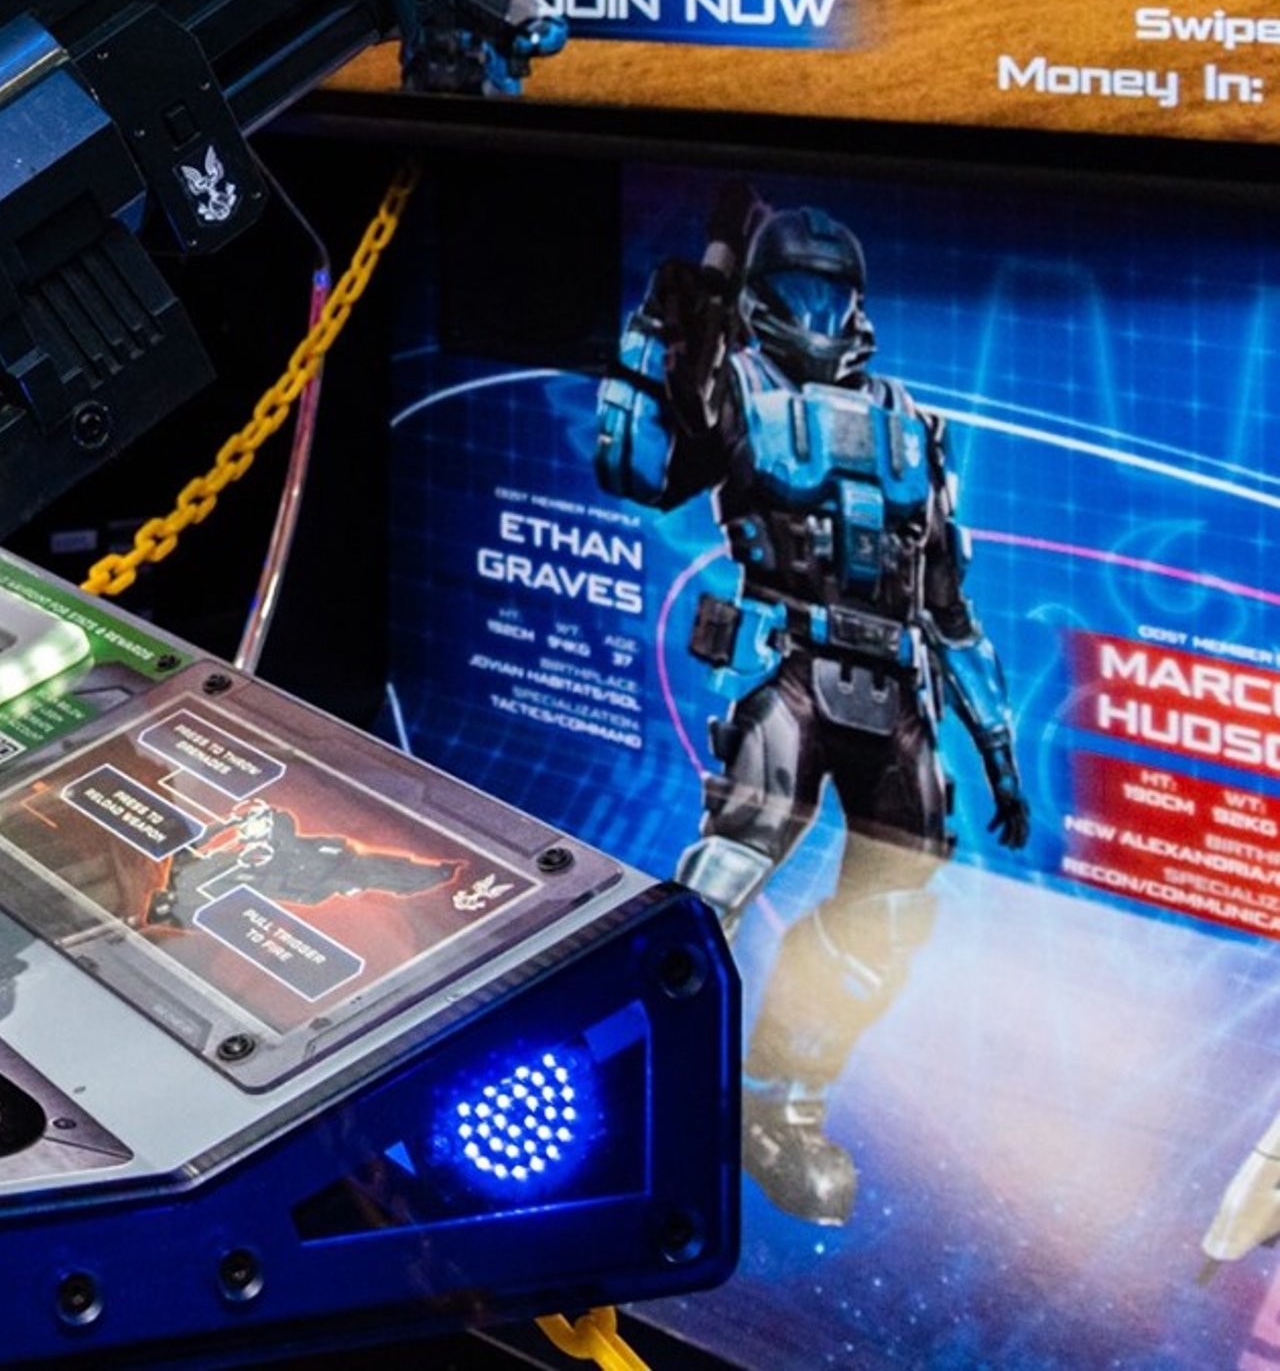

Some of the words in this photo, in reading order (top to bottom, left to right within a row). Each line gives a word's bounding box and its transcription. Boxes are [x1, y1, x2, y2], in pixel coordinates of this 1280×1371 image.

[1135, 7, 1280, 50] Swipe
[998, 55, 1179, 108] Money
[1205, 63, 1263, 103] In:
[500, 510, 643, 571] ETHAN
[477, 547, 643, 615] GRAVES
[103, 629, 155, 661] REWARDS
[1193, 636, 1273, 665] MEMBER
[1100, 642, 1280, 722] MARC
[490, 692, 643, 751] TACTICS/COMMAND
[173, 724, 210, 747] PRESS
[208, 742, 225, 755] TO
[222, 750, 262, 775] THROW
[175, 740, 232, 775] GRENADES
[83, 787, 125, 816] RELOAD
[122, 811, 168, 843] WEAPON
[113, 790, 150, 816] PRESS
[146, 810, 164, 825] TO
[1063, 814, 1116, 843] NEW
[1119, 830, 1280, 889] ALEXANDRIA/
[242, 908, 275, 932] PULL
[273, 926, 327, 965] TRIGGER
[245, 928, 265, 943] TO
[261, 939, 294, 962] FIRE
